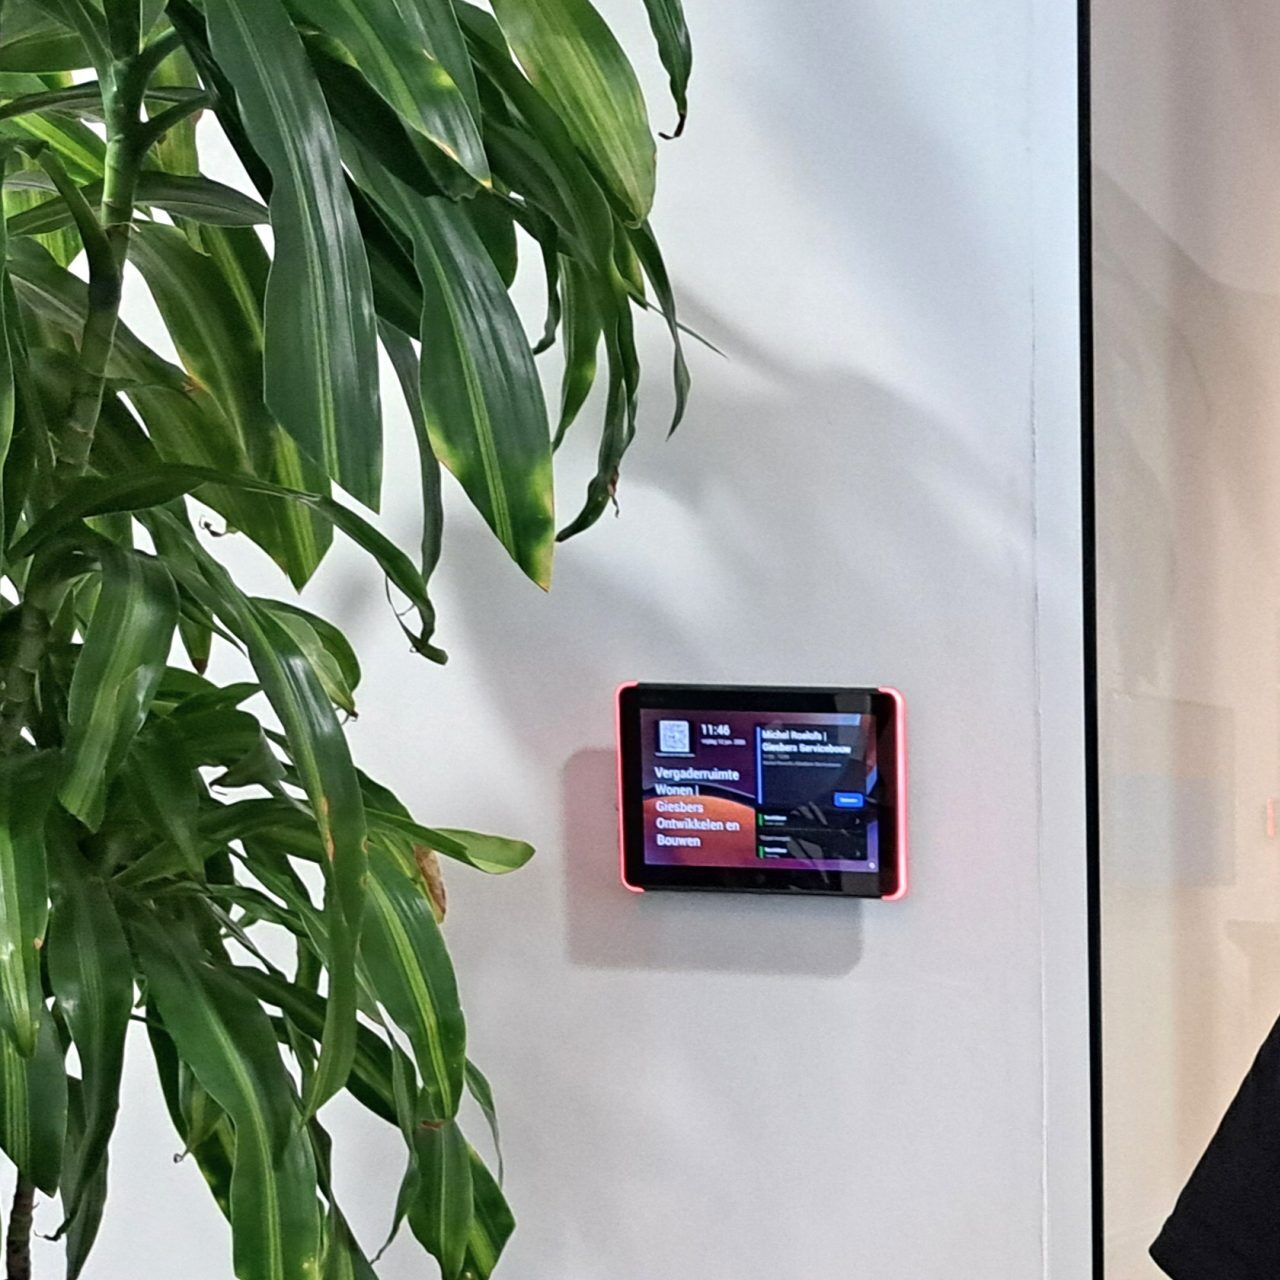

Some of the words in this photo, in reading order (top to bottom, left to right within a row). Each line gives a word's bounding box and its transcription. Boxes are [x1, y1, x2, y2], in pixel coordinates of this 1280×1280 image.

[654, 766, 740, 781] Vergaderruimte
[655, 783, 694, 796] Wonen
[655, 800, 704, 813] Giesbers
[656, 817, 724, 831] Ontwikkelen
[725, 821, 740, 831] en
[656, 833, 701, 847] Bouwen
